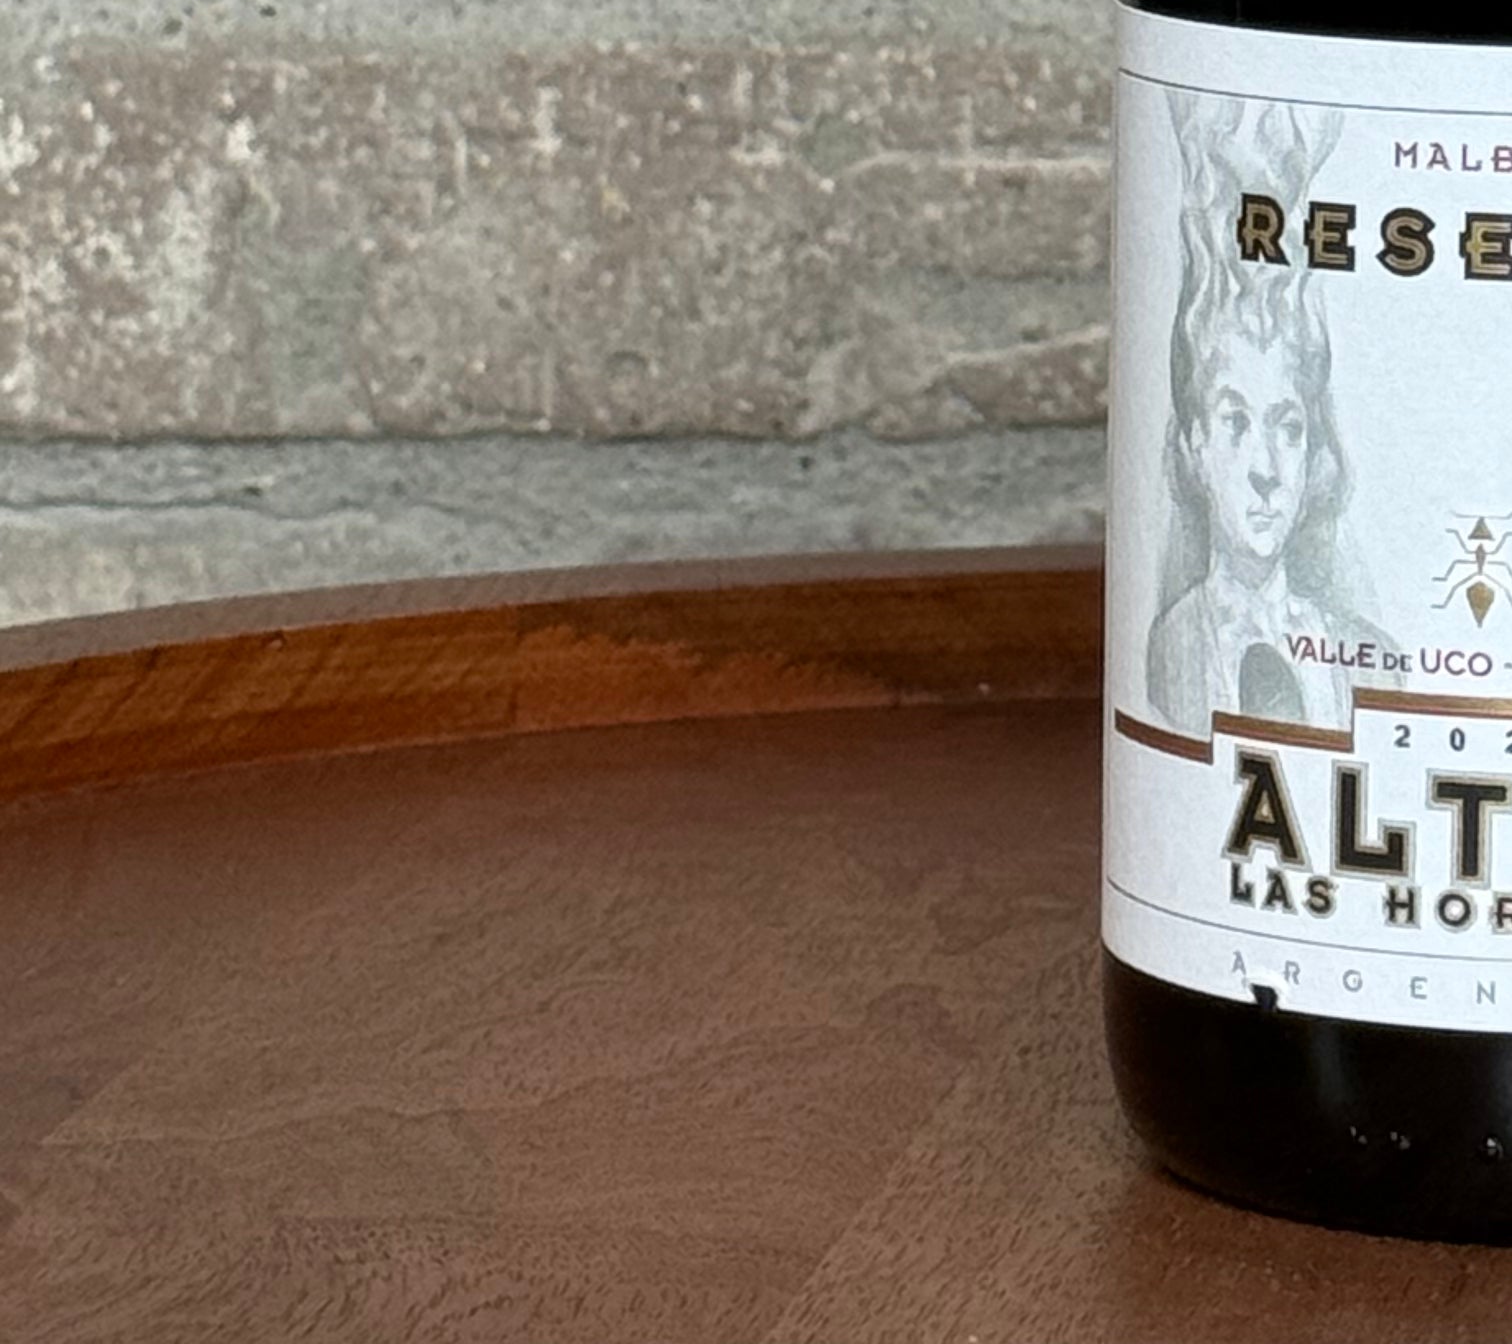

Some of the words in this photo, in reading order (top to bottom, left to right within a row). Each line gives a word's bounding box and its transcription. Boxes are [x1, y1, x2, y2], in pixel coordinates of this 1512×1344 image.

[1285, 633, 1377, 669] VALLE
[1420, 647, 1493, 678] UCO
[1229, 862, 1339, 919] LAS
